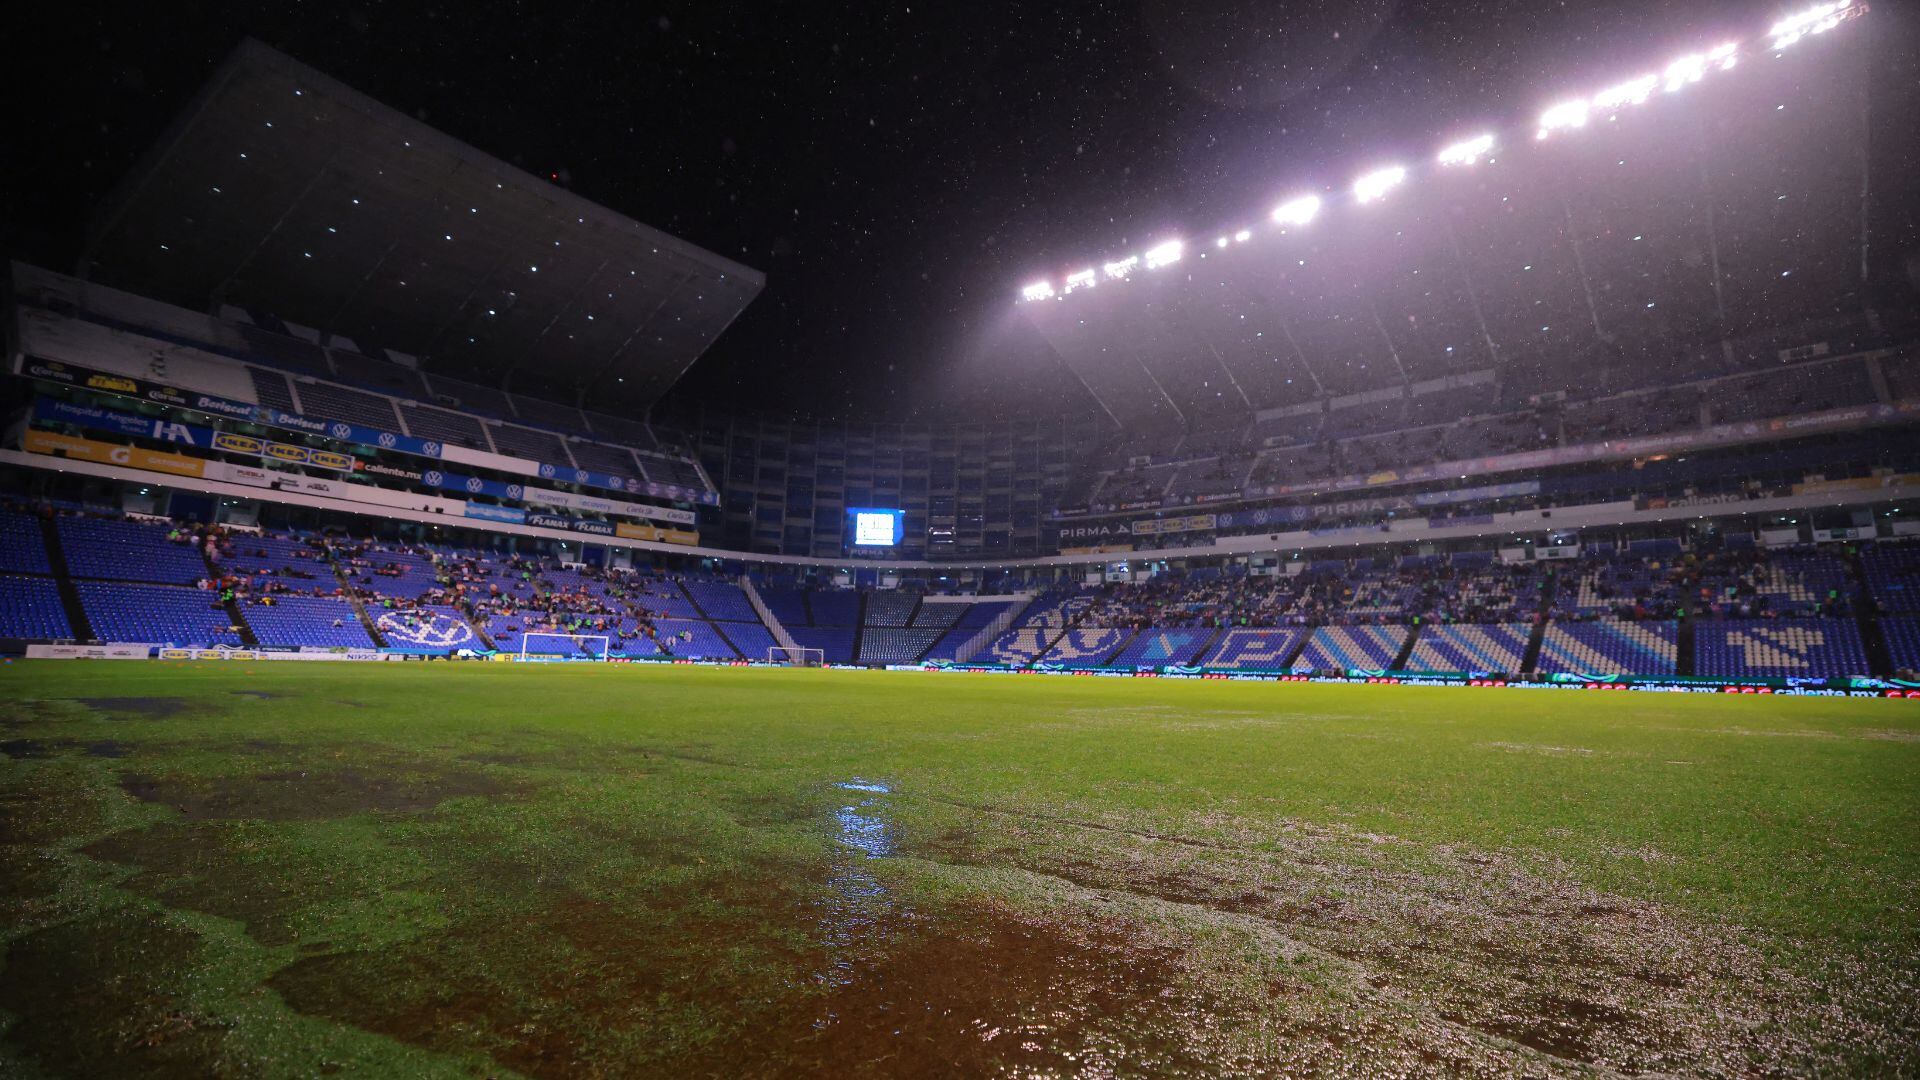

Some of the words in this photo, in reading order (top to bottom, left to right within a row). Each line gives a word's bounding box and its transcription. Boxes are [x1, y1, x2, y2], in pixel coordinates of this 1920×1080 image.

[54, 401, 102, 418] Hospital
[1786, 412, 1868, 429] caliente.mx
[219, 437, 258, 450] IKEA
[269, 446, 305, 458] IKEA
[314, 454, 347, 466] IKEA
[365, 463, 422, 480] caliente.mx
[1668, 490, 1774, 508] calientex
[1314, 501, 1384, 517] PIRMA
[533, 517, 569, 529] FLANAX
[579, 522, 612, 535] FLANAX
[1060, 526, 1110, 538] PIRMA
[1308, 676, 1366, 684] calientemx
[1400, 679, 1466, 687] calientemx
[1507, 681, 1583, 690] calientemx
[1629, 684, 1717, 693] calientemx
[1774, 687, 1880, 698] calientemx
